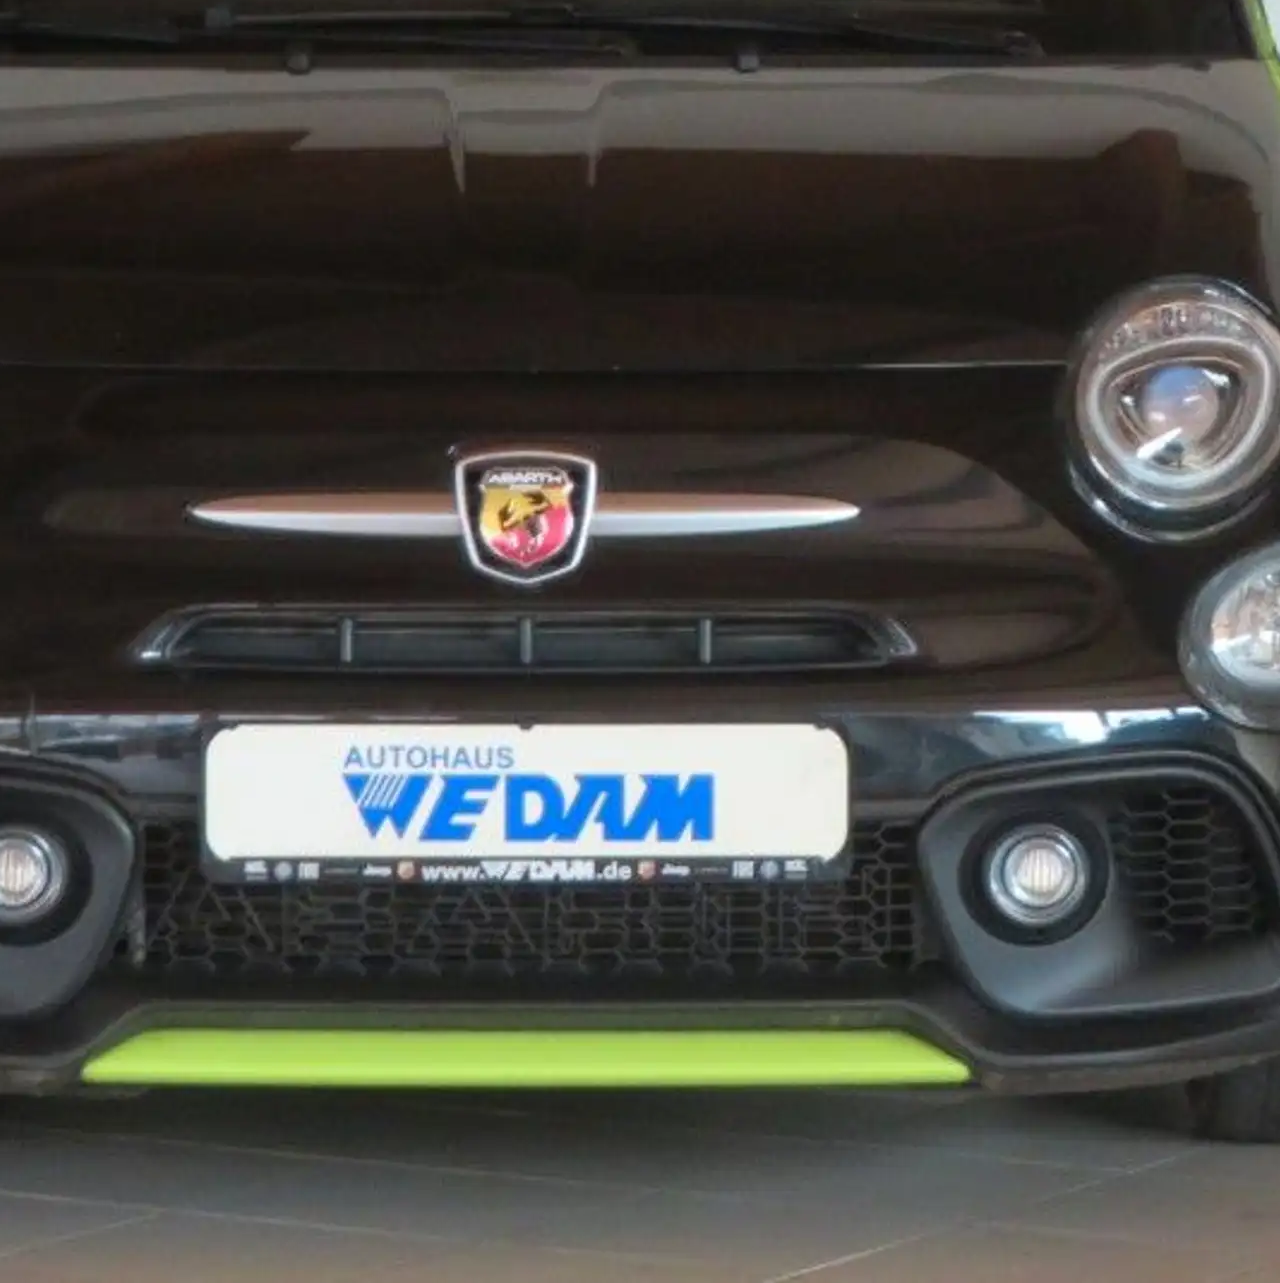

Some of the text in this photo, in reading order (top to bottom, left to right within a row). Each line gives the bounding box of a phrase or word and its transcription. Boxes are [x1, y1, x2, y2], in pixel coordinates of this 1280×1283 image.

[489, 470, 563, 485] ABARTH
[343, 744, 516, 771] AUTOHAUS
[342, 774, 716, 843] WEDAM
